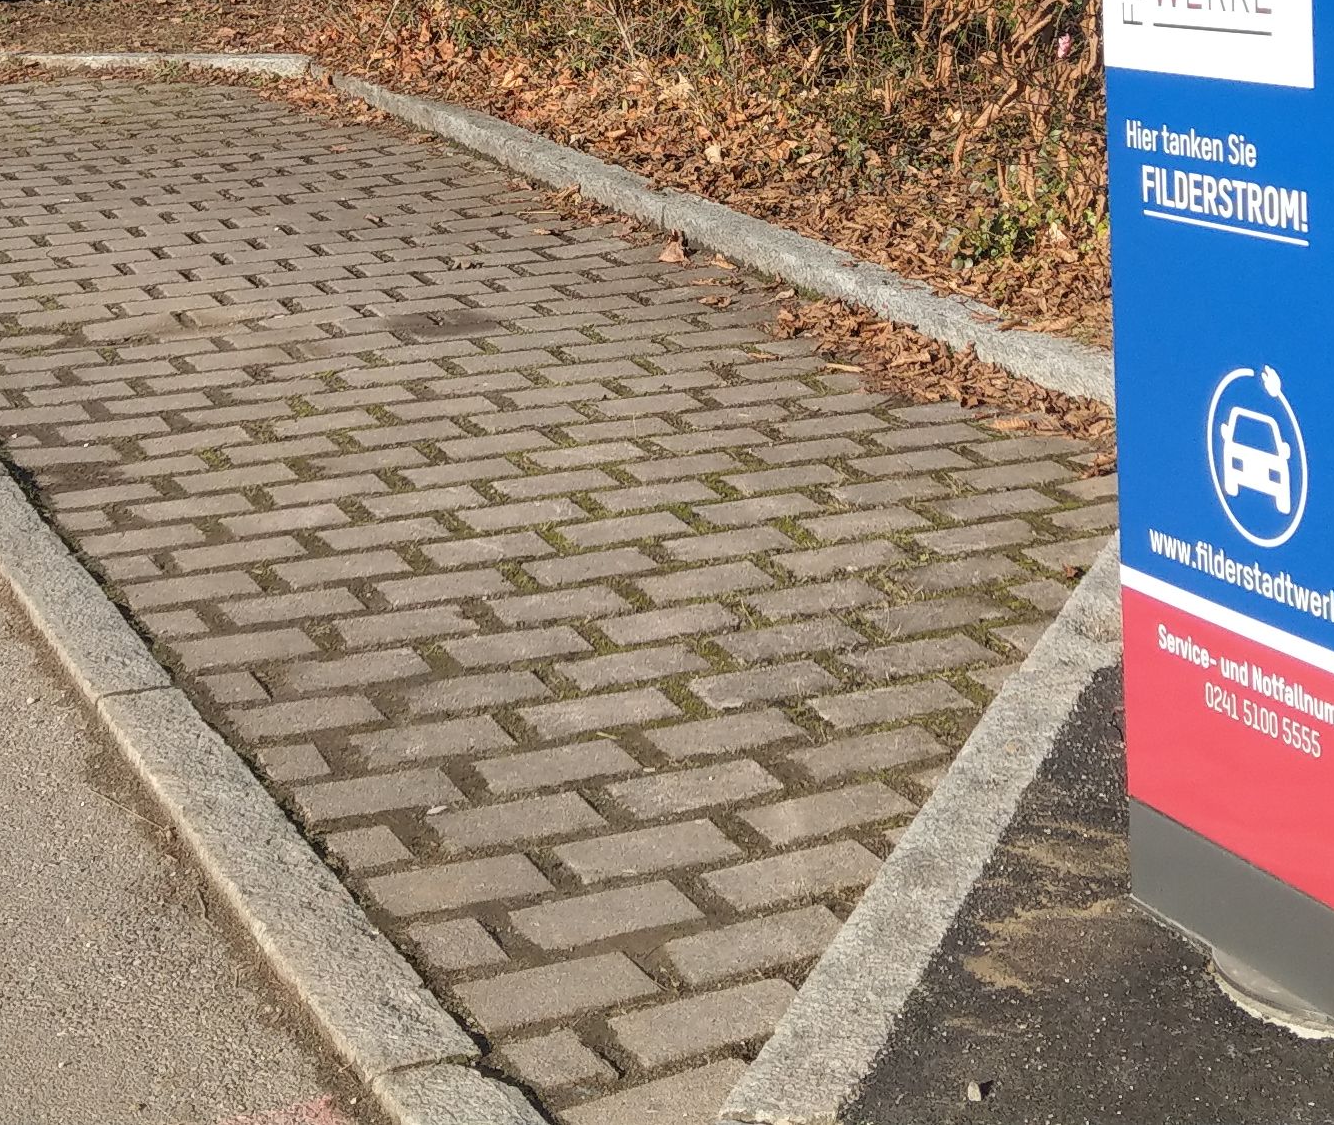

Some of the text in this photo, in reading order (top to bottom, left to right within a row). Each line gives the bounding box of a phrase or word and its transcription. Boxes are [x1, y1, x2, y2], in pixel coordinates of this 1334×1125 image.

[1126, 118, 1258, 168] Hier tanken Sie
[1141, 164, 1309, 233] FILDERSTROM!
[1157, 623, 1217, 669] Service-
[1220, 656, 1249, 687] und
[1204, 681, 1321, 758] 0241 5100 5555
